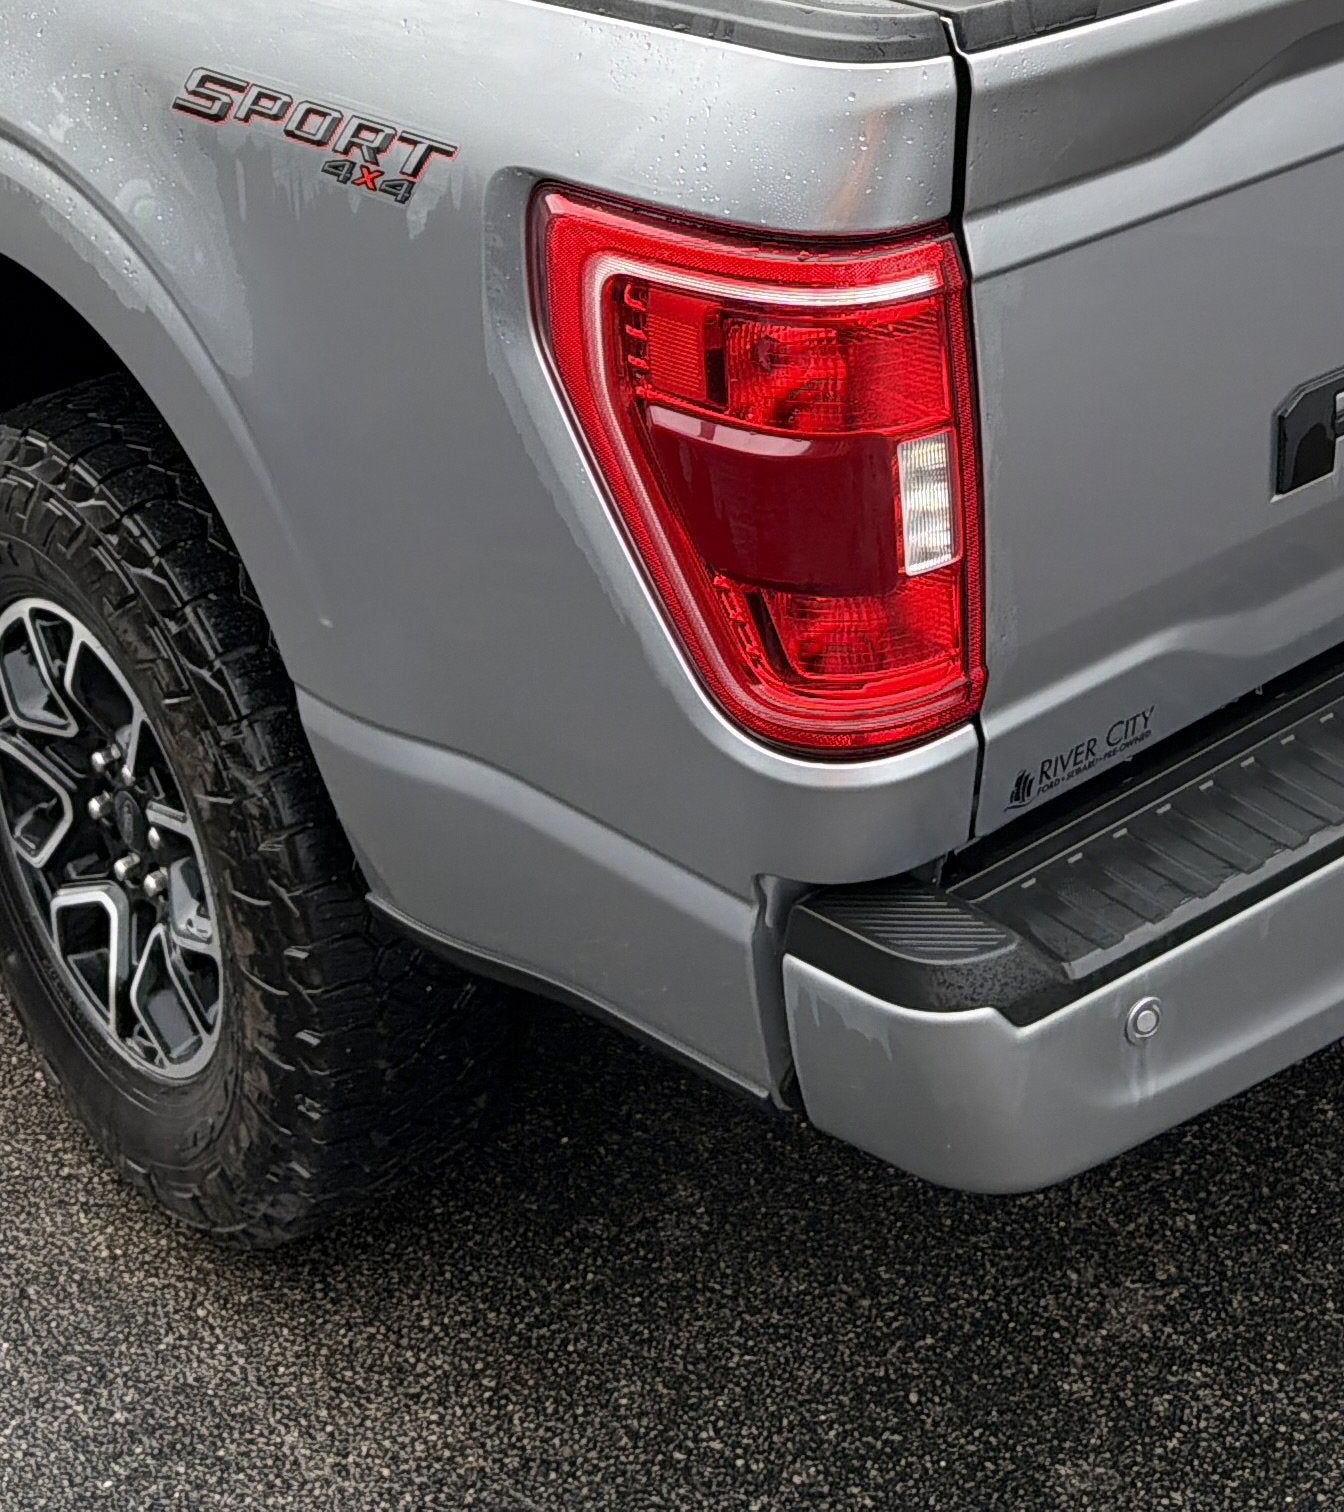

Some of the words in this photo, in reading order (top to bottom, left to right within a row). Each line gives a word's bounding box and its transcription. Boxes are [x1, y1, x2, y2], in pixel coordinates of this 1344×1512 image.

[171, 66, 458, 180] SPORT
[1038, 738, 1098, 785] RIVER
[1106, 705, 1155, 747] CITY
